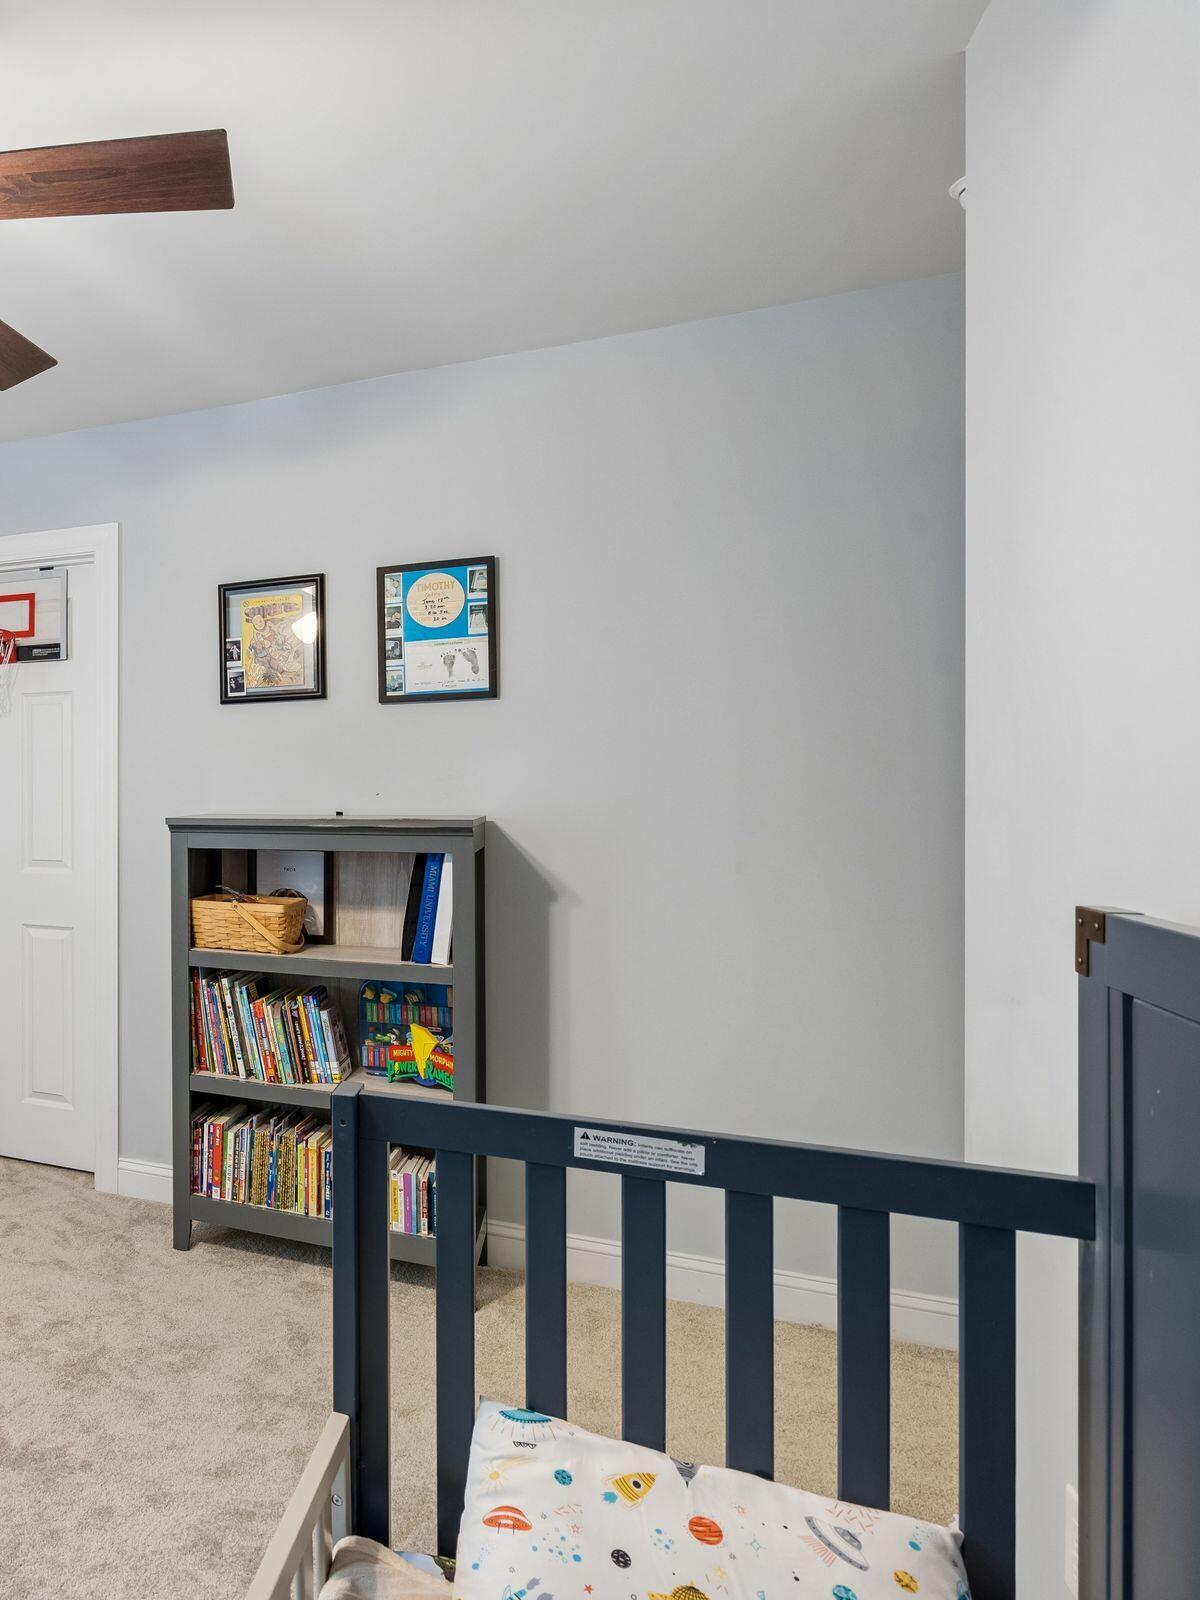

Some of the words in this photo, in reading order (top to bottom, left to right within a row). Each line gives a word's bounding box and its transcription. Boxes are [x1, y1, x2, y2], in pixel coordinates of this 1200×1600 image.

[416, 580, 456, 592] TIMOTHY
[428, 865, 439, 892] MIAMI
[420, 896, 434, 947] UNIVERSITY
[392, 1049, 413, 1058] MIGHTY
[592, 1135, 637, 1147] WARNING:
